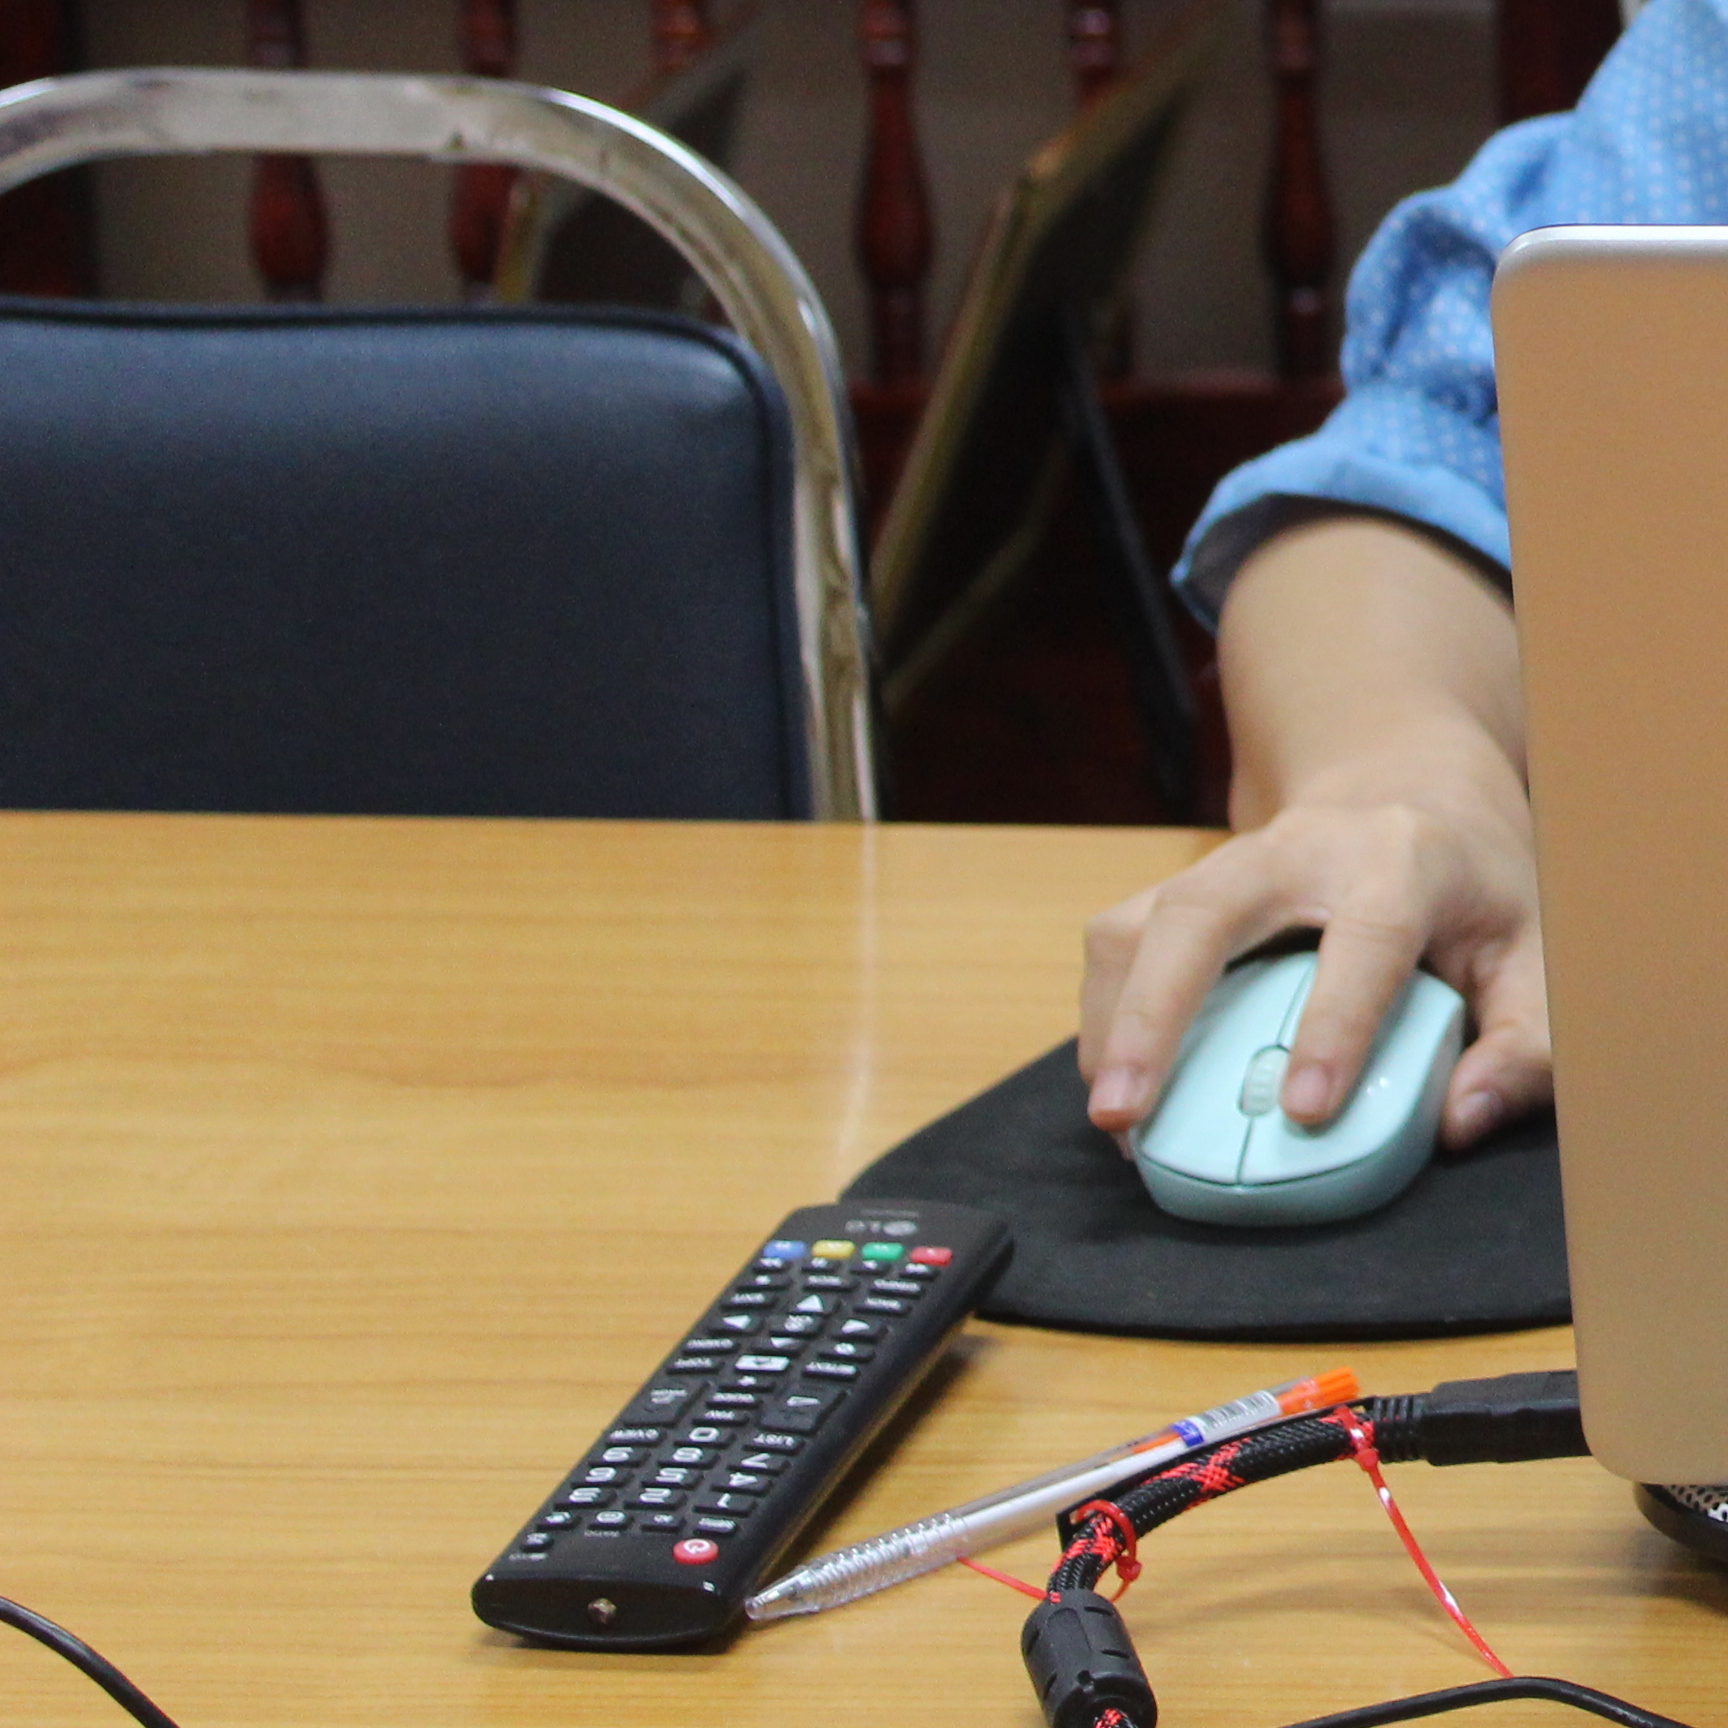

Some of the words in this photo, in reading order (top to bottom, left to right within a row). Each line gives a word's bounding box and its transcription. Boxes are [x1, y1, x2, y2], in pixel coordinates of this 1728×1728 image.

[689, 1426, 720, 1443] 0
[753, 1433, 795, 1446] LIST
[602, 1446, 634, 1463] 9
[672, 1446, 704, 1463] 8
[741, 1453, 771, 1469] 7
[585, 1466, 617, 1483] 6
[655, 1467, 689, 1484] 5
[729, 1472, 758, 1487] 4
[568, 1487, 601, 1503] 3
[639, 1487, 672, 1503] 2
[716, 1492, 731, 1509] 1
